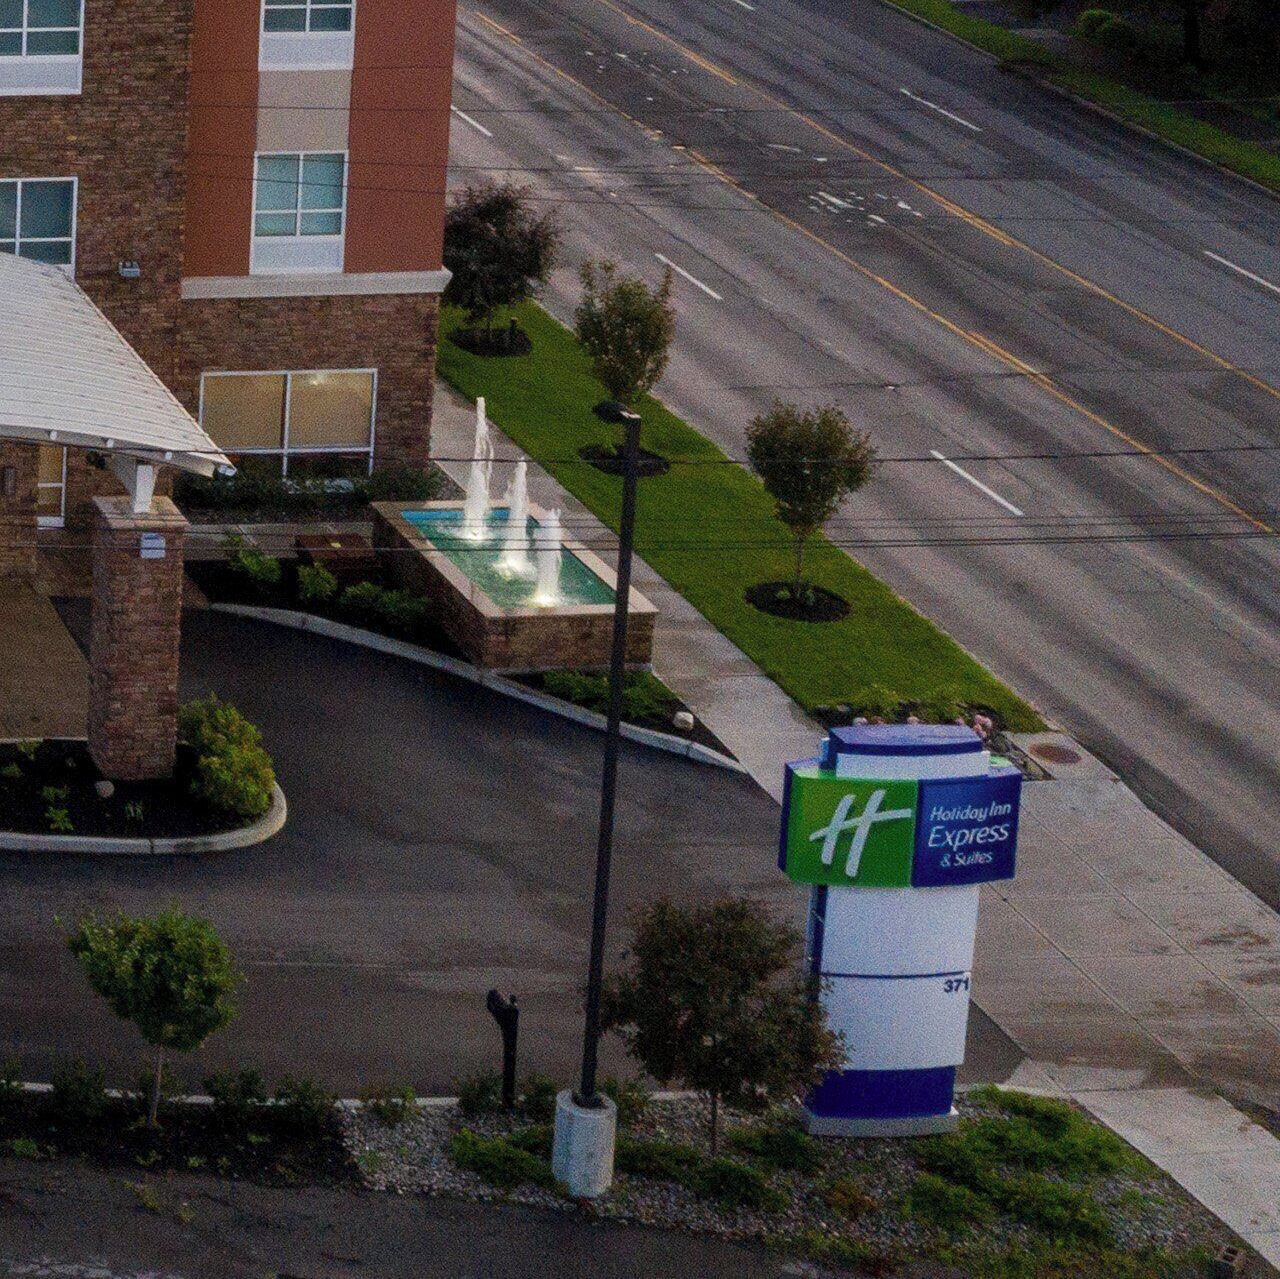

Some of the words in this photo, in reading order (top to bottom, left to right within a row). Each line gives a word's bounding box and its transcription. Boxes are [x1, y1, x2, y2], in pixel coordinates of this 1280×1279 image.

[930, 804, 989, 822] Holiday
[989, 801, 1012, 817] Inn
[928, 823, 1010, 852] Express
[941, 853, 952, 867] &
[954, 852, 994, 867] Suites
[944, 977, 969, 993] 371
